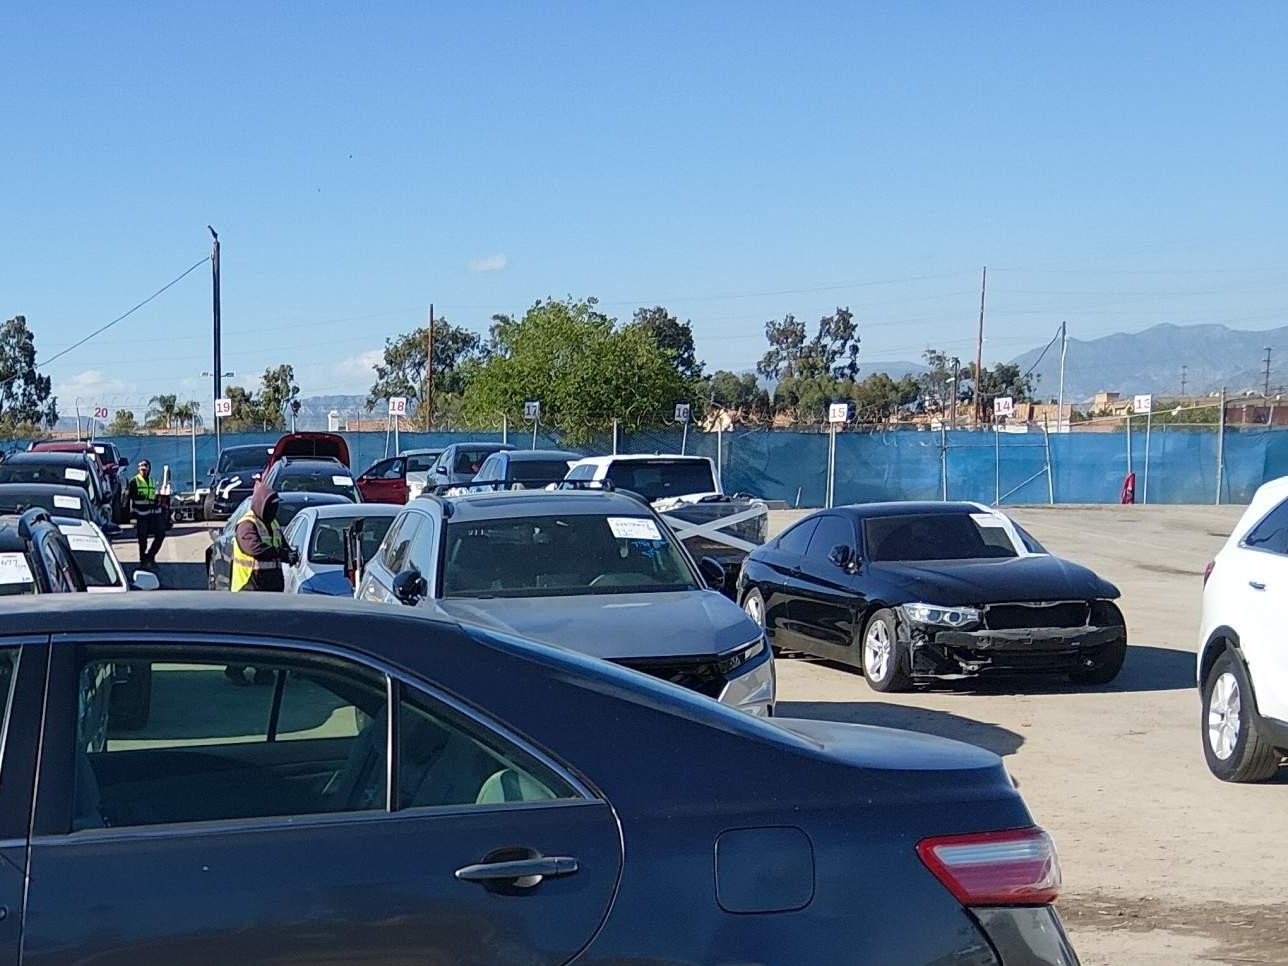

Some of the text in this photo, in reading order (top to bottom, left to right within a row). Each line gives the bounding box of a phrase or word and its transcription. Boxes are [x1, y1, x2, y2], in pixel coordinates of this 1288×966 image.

[217, 402, 230, 413] 19
[391, 401, 404, 412] 18
[996, 401, 1010, 412] 14
[1136, 398, 1150, 409] 13
[94, 407, 108, 418] 20
[526, 405, 537, 415] 17
[831, 408, 845, 418] 15
